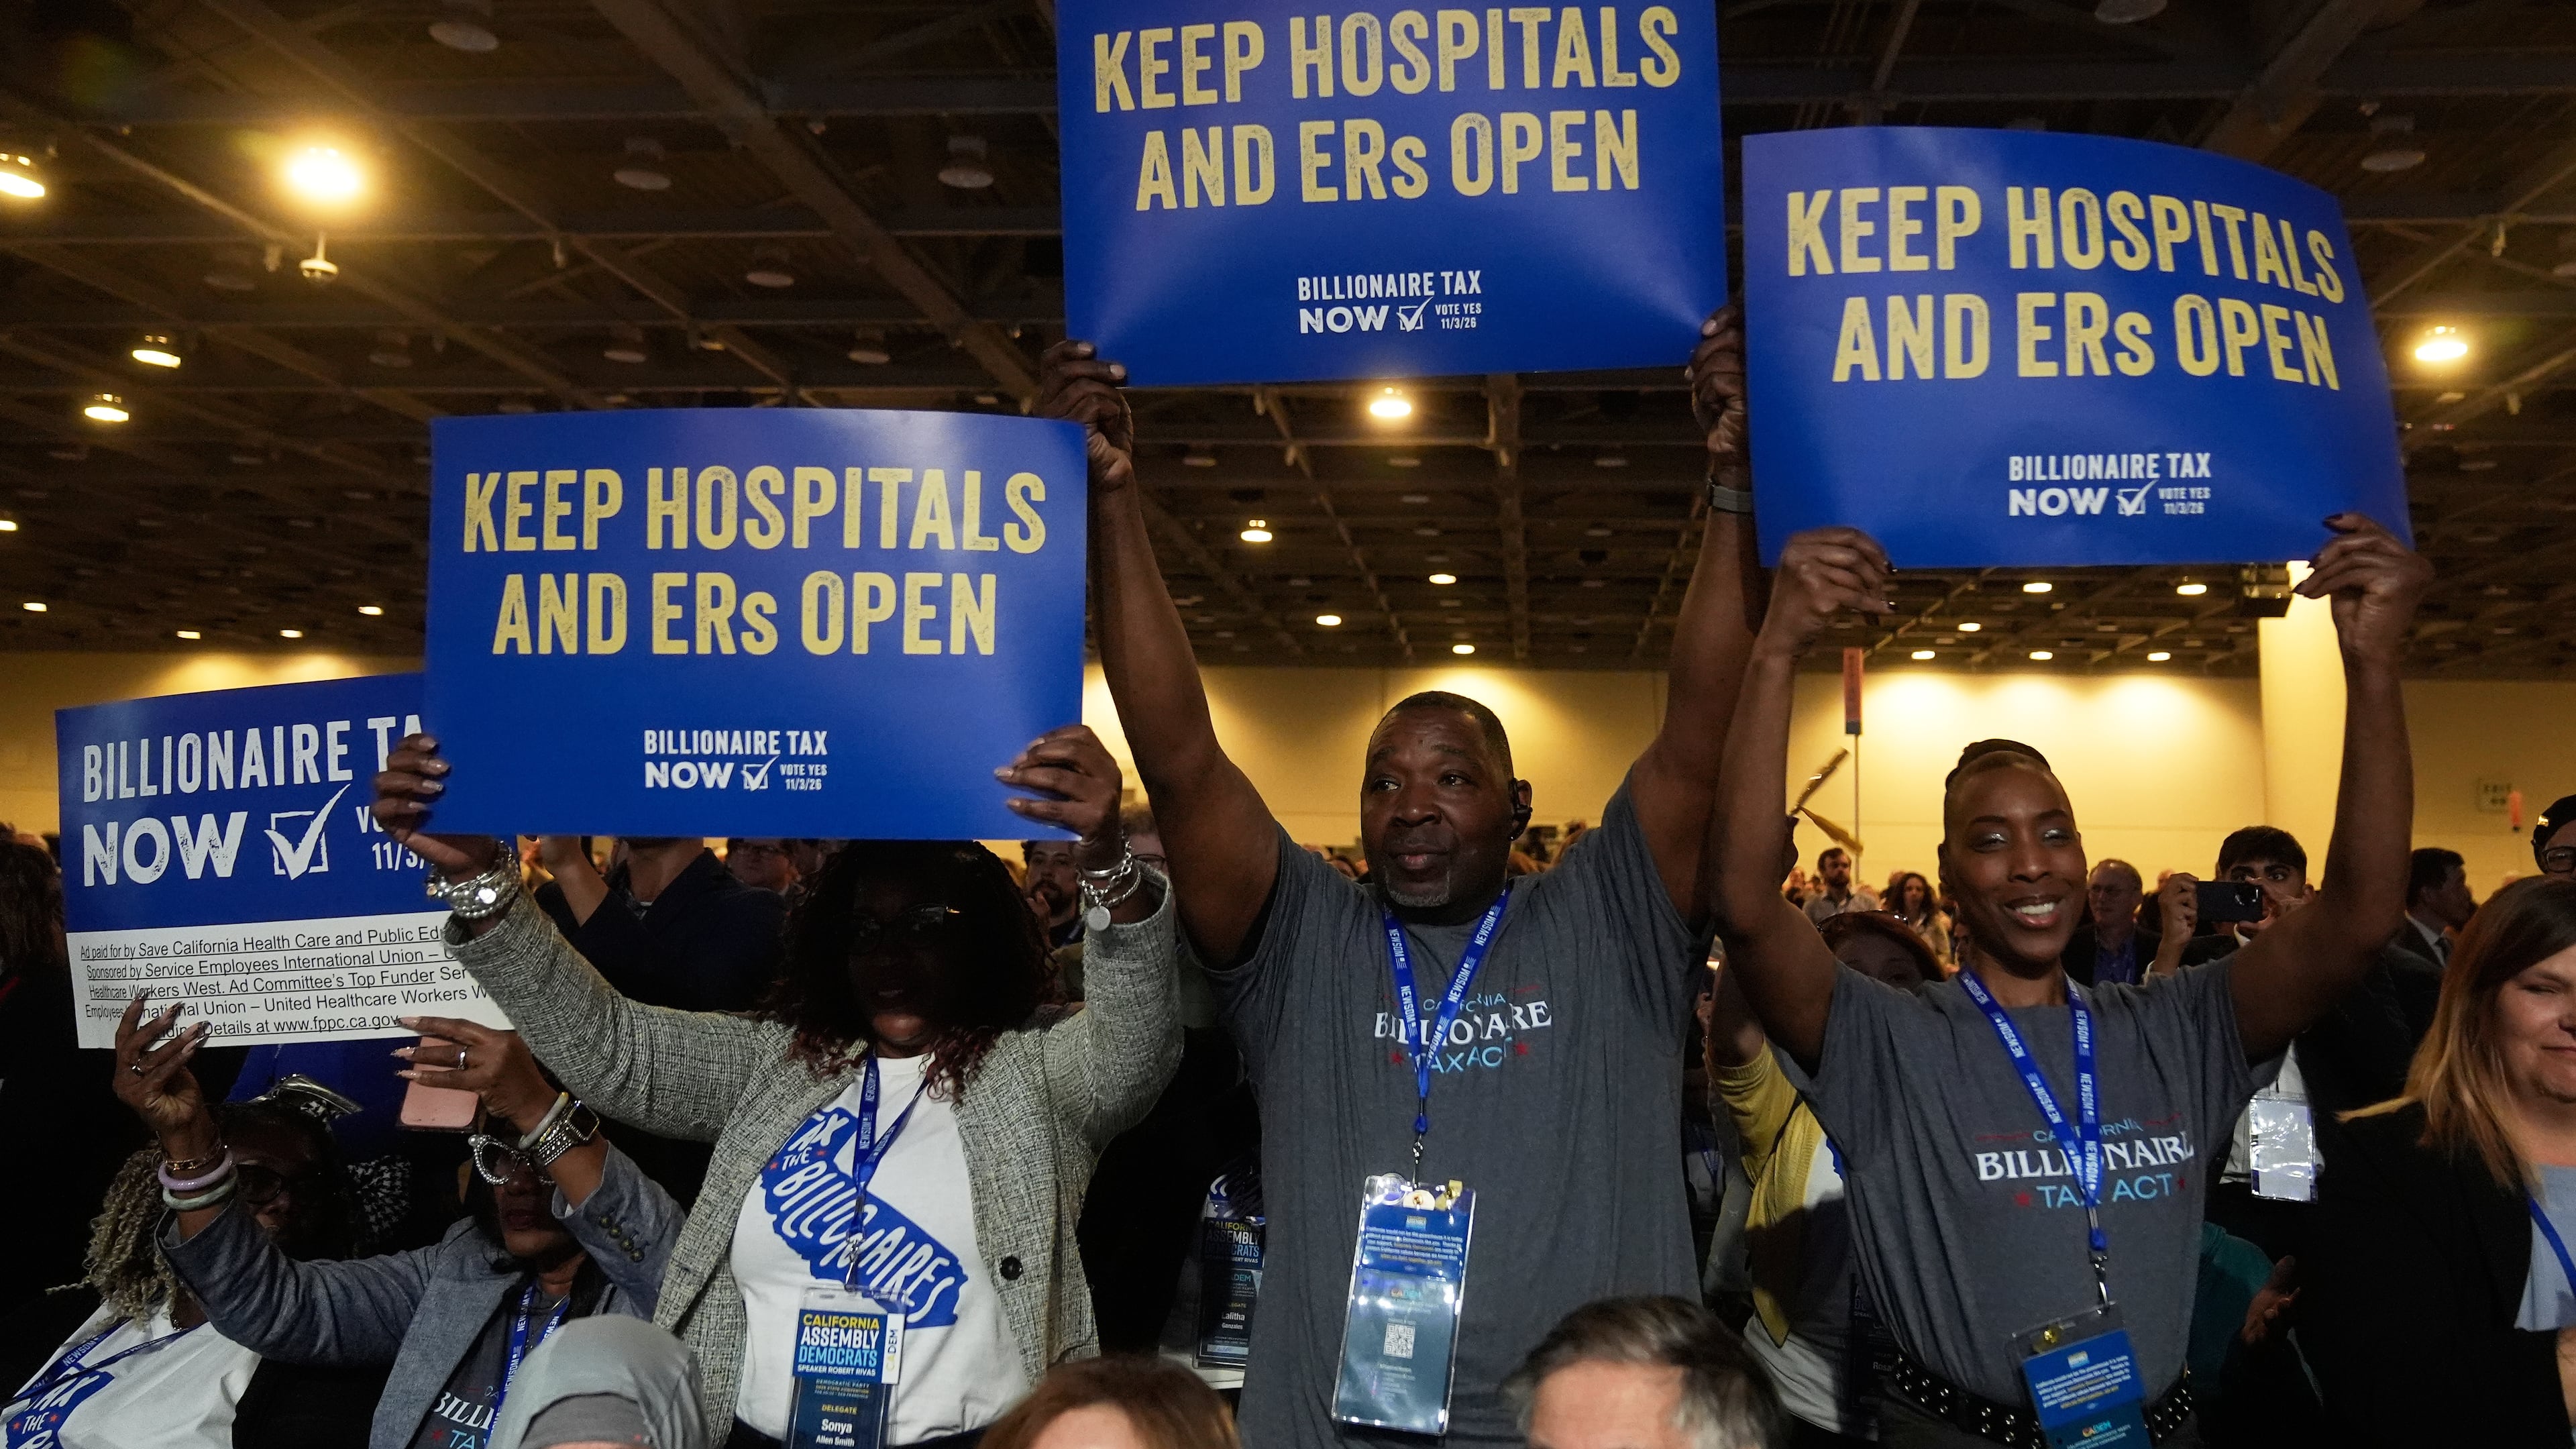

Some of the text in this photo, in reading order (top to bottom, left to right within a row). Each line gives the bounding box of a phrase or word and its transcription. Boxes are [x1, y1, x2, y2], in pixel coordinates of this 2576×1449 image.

[1094, 6, 1680, 113] KEEP HOSPITALS
[1136, 109, 1640, 211] AND ERs OPEN
[1787, 185, 2344, 303] KEEP HOSPITALS
[1297, 270, 1482, 301] BILLIONAIRE TAX
[1299, 305, 1389, 333] NOW
[1434, 303, 1482, 315] VOTE YES
[1440, 317, 1477, 329] 11/3/26
[1832, 292, 2339, 390] AND ERs OPEN
[2008, 452, 2212, 482] BILLIONAIRE TAX
[2008, 487, 2110, 517] NOW
[2157, 487, 2211, 499] VOTE YES
[464, 465, 1046, 554] KEEP HOSPITALS
[2163, 502, 2205, 515] 11/3/26
[492, 570, 997, 656] AND ERs OPEN
[644, 729, 828, 755] BILLIONAIRE TAX
[84, 720, 353, 804] BILLIONAIRE
[644, 761, 735, 789] NOW
[780, 763, 828, 776] VOTE YES
[785, 777, 822, 791] 11/3/26
[84, 811, 248, 886] NOW
[80, 945, 90, 959] Ad
[92, 945, 107, 960] paid
[110, 944, 121, 958] for
[124, 944, 136, 960] by
[139, 943, 168, 957] Save
[172, 938, 239, 955] California
[244, 934, 290, 951] Health
[295, 933, 330, 948] Care
[335, 930, 363, 946] and
[368, 927, 414, 944] Public
[1389, 928, 1405, 958] NEWSOM
[1474, 914, 1497, 947] NEWSOM
[87, 965, 127, 981] Sponsored
[130, 964, 142, 981] by
[145, 962, 194, 977] Service
[199, 958, 279, 977] Employees
[284, 950, 374, 970] International
[379, 949, 424, 964] Union
[89, 984, 127, 998] Healthcare
[183, 980, 225, 996] West.
[229, 979, 248, 994] Ad
[254, 973, 344, 991] Committee’s
[348, 972, 376, 988] Top
[380, 969, 435, 984] Funder
[1448, 967, 1471, 1004] NEWSOM
[85, 1004, 125, 1021] Employees
[204, 1000, 246, 1014] Union
[264, 996, 311, 1012] United
[317, 993, 396, 1009] Healthcare
[401, 988, 468, 1004] Workers
[1401, 985, 1417, 1024] NEWSOM
[204, 1020, 252, 1035] Details
[256, 1022, 269, 1032] at
[2075, 1009, 2091, 1044] NEWSOM
[2080, 1073, 2094, 1114] NEWSOM
[782, 1146, 813, 1171] THE
[2084, 1140, 2099, 1183] NEWSOM
[2111, 1173, 2172, 1203] ACT
[803, 1313, 880, 1330] CALIFORNIA
[1222, 1311, 1246, 1322] Lalitha
[800, 1326, 879, 1350] ASSEMBLY
[62, 1339, 97, 1367] NEWSOM
[798, 1345, 877, 1368] DEMOCRATS
[797, 1364, 876, 1377] SPEAKER ROBERT RIVAS
[21, 1411, 50, 1435] THE
[822, 1403, 858, 1415] DELEGATE
[821, 1418, 853, 1436] Sonya
[835, 1435, 855, 1447] Smith
